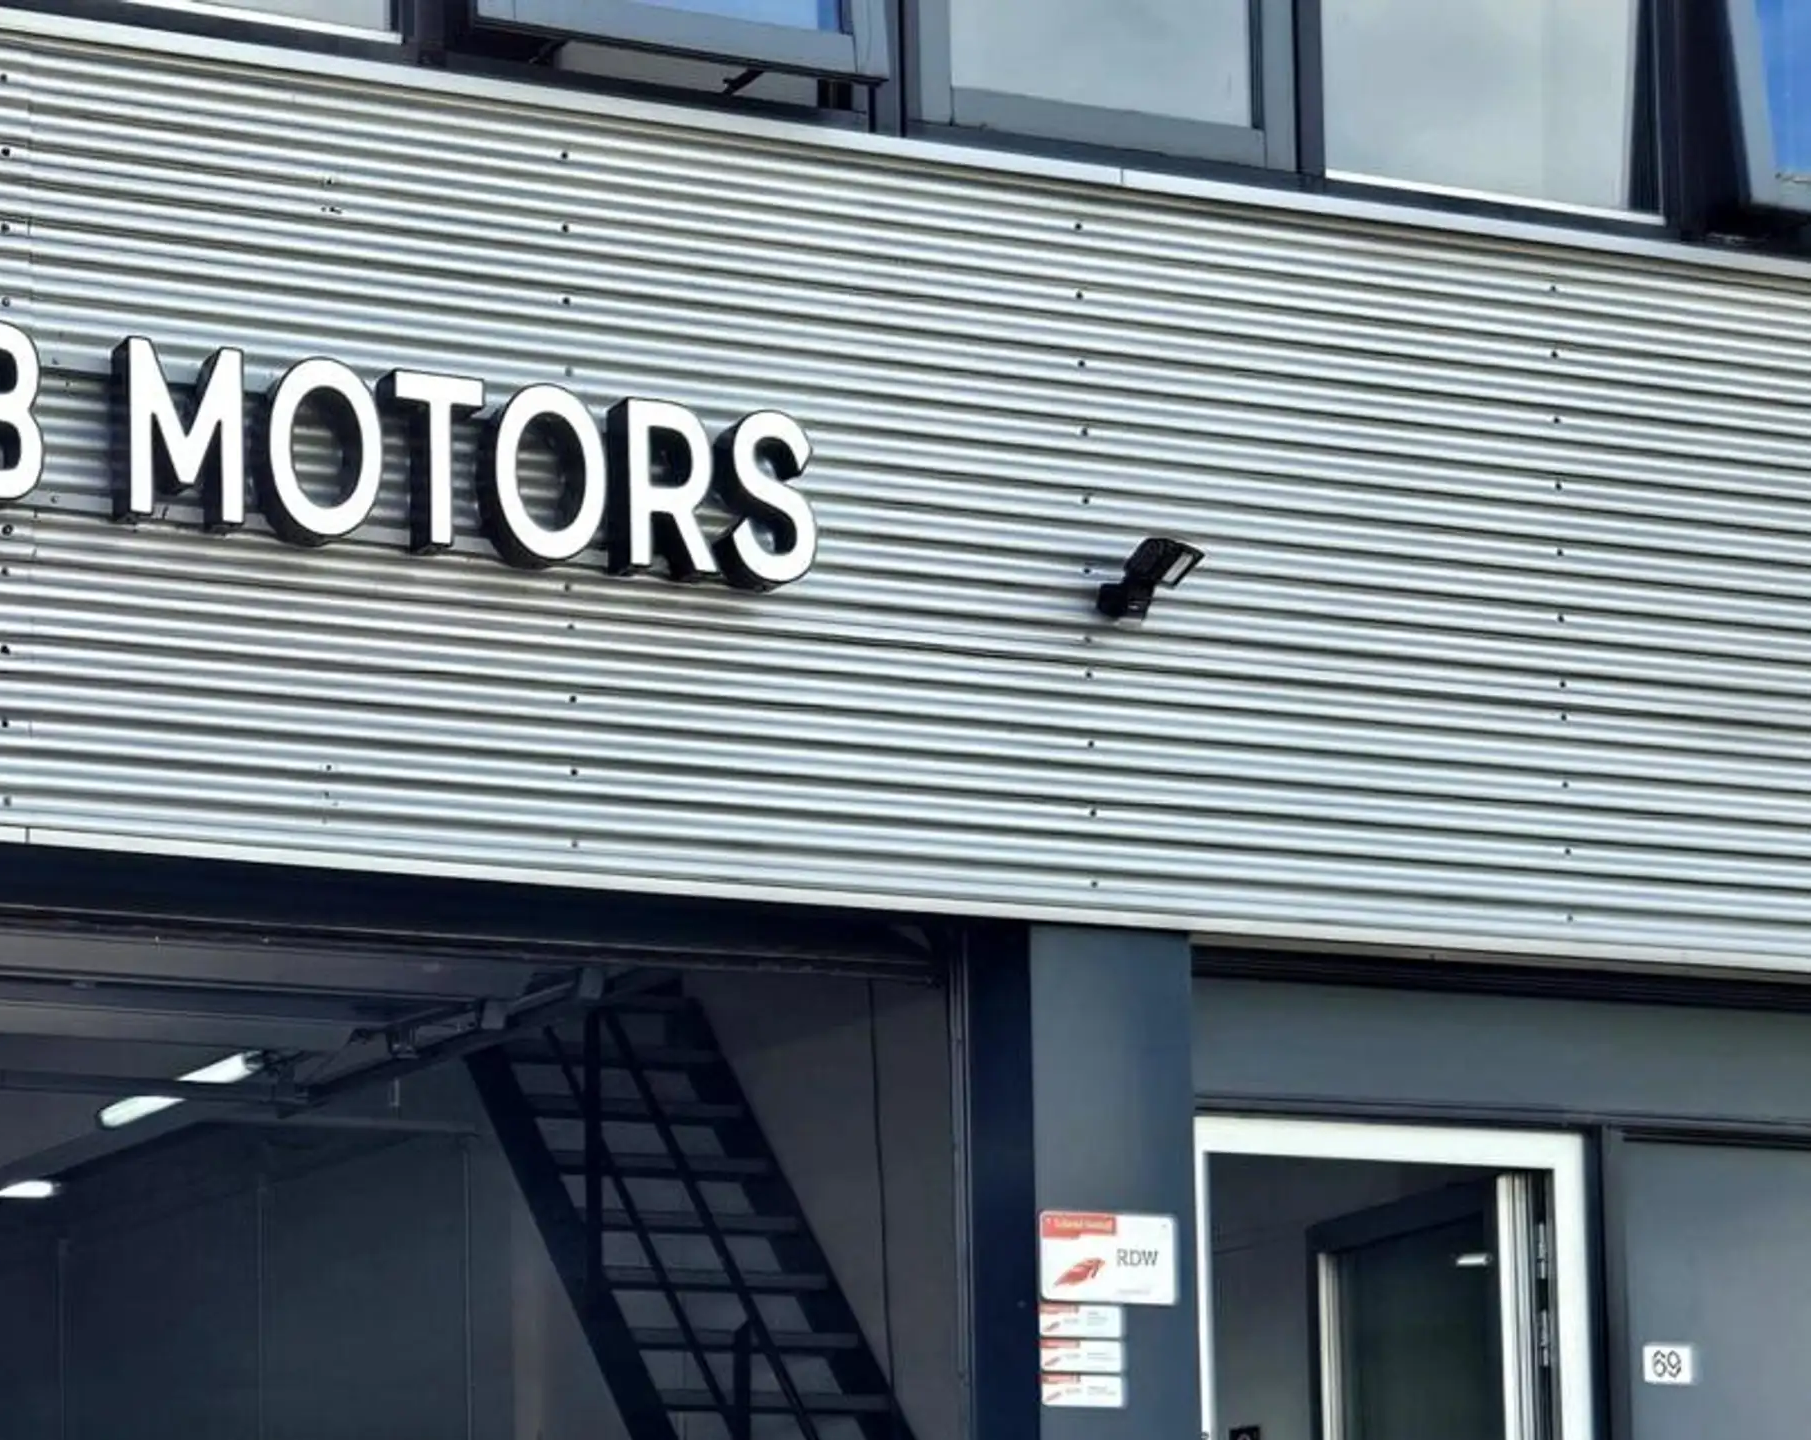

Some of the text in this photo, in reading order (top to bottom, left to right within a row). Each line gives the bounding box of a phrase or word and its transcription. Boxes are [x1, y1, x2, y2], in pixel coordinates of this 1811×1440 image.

[116, 335, 817, 586] MOTORS
[1116, 1248, 1159, 1268] RDW
[1652, 1349, 1682, 1379] 69
